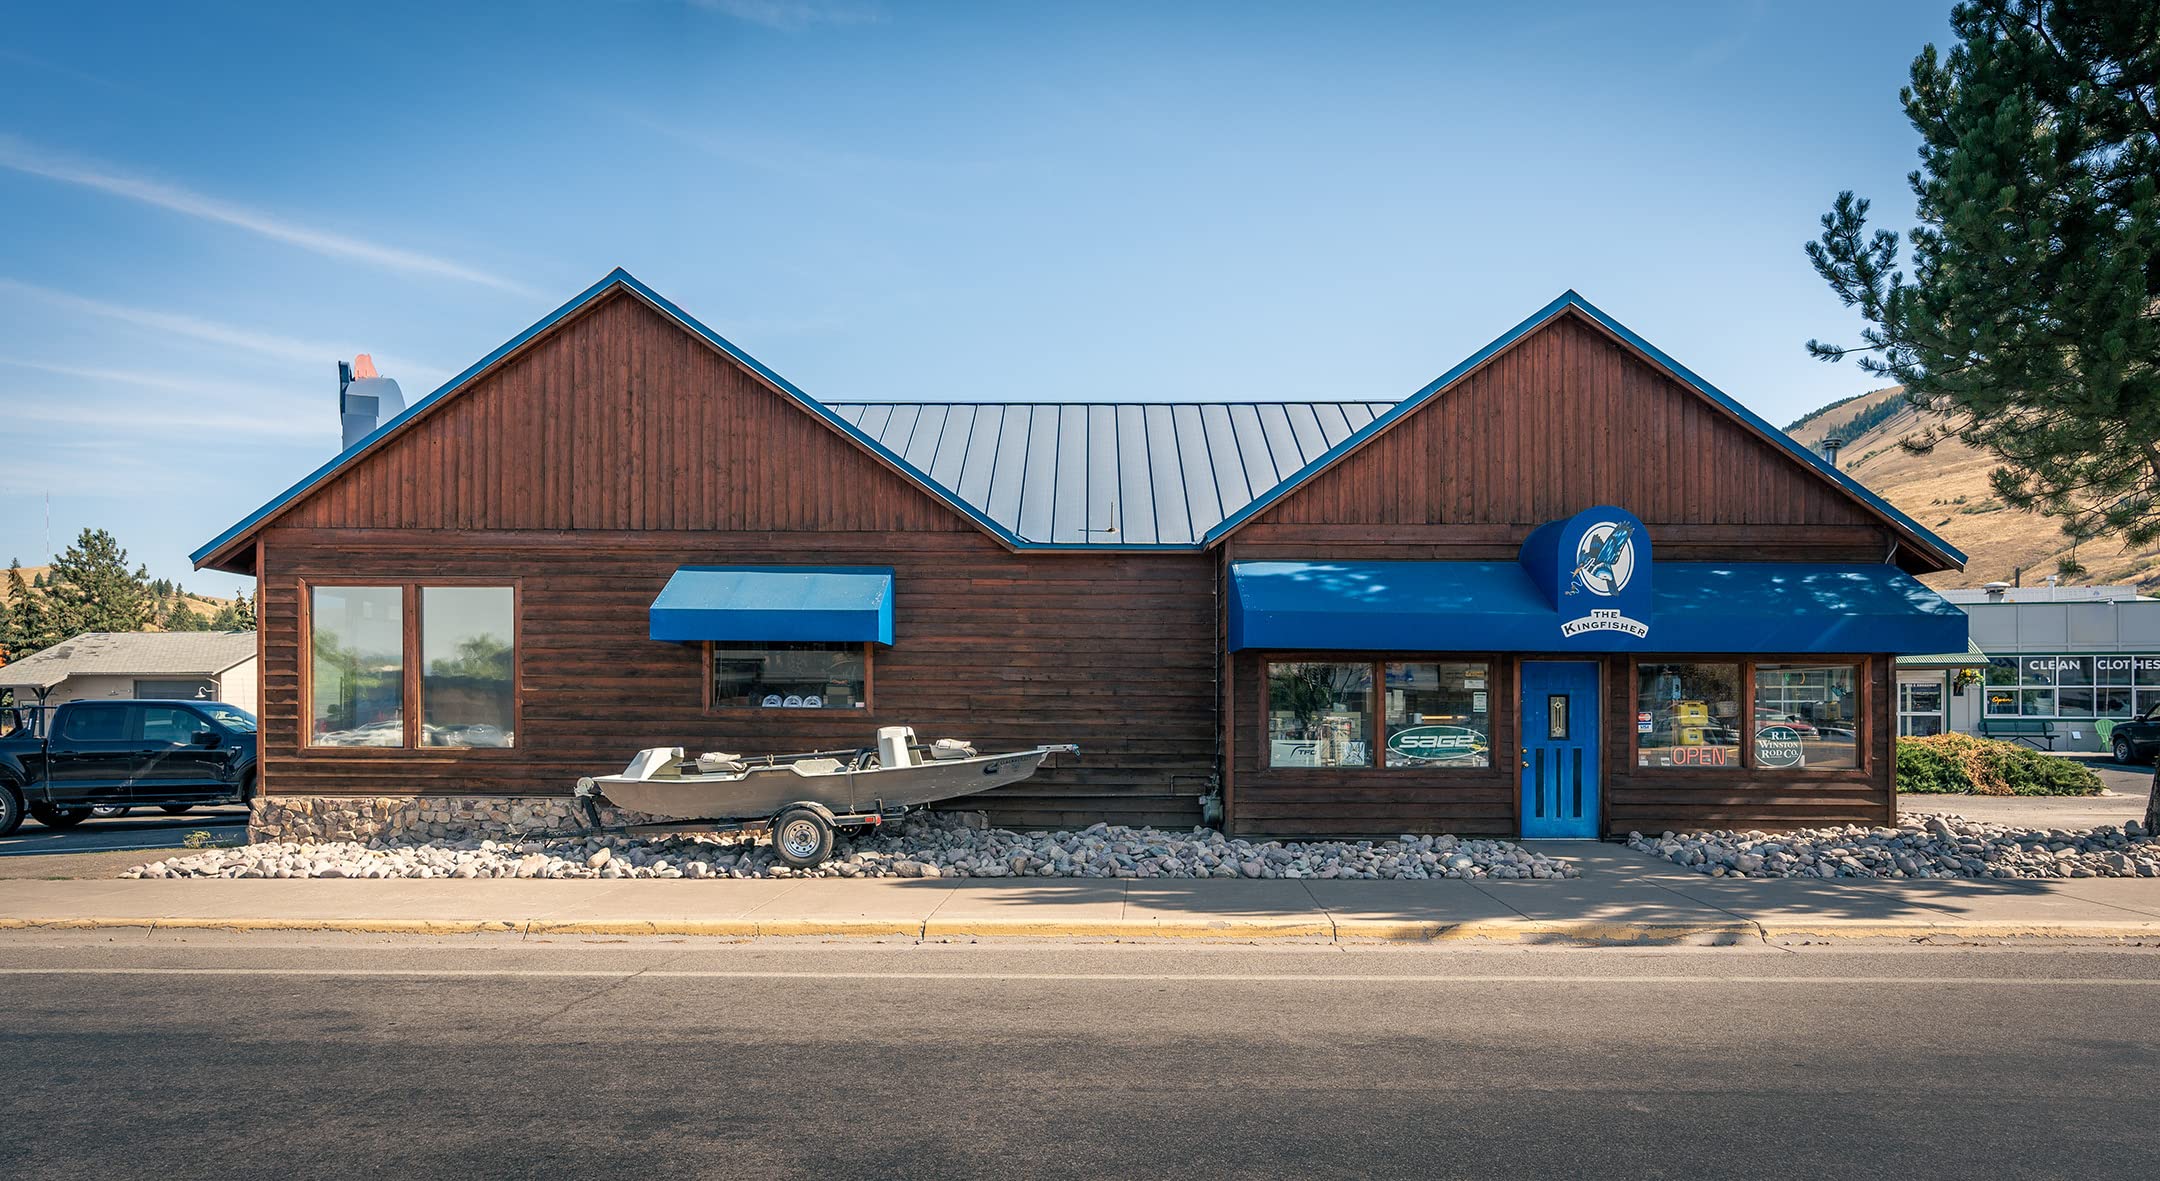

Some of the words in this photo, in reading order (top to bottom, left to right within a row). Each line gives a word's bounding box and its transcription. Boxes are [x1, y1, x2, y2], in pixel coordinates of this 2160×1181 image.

[1564, 621, 1645, 636] KINGFISHER
[2029, 660, 2080, 670] CLEAN
[2097, 660, 2160, 670] CLOTHES
[1771, 731, 1791, 740] R.L.
[1759, 740, 1798, 749] WINSTON
[1673, 747, 1725, 765] OPEN
[1761, 750, 1782, 759] ROD
[1783, 749, 1799, 759] CO.
